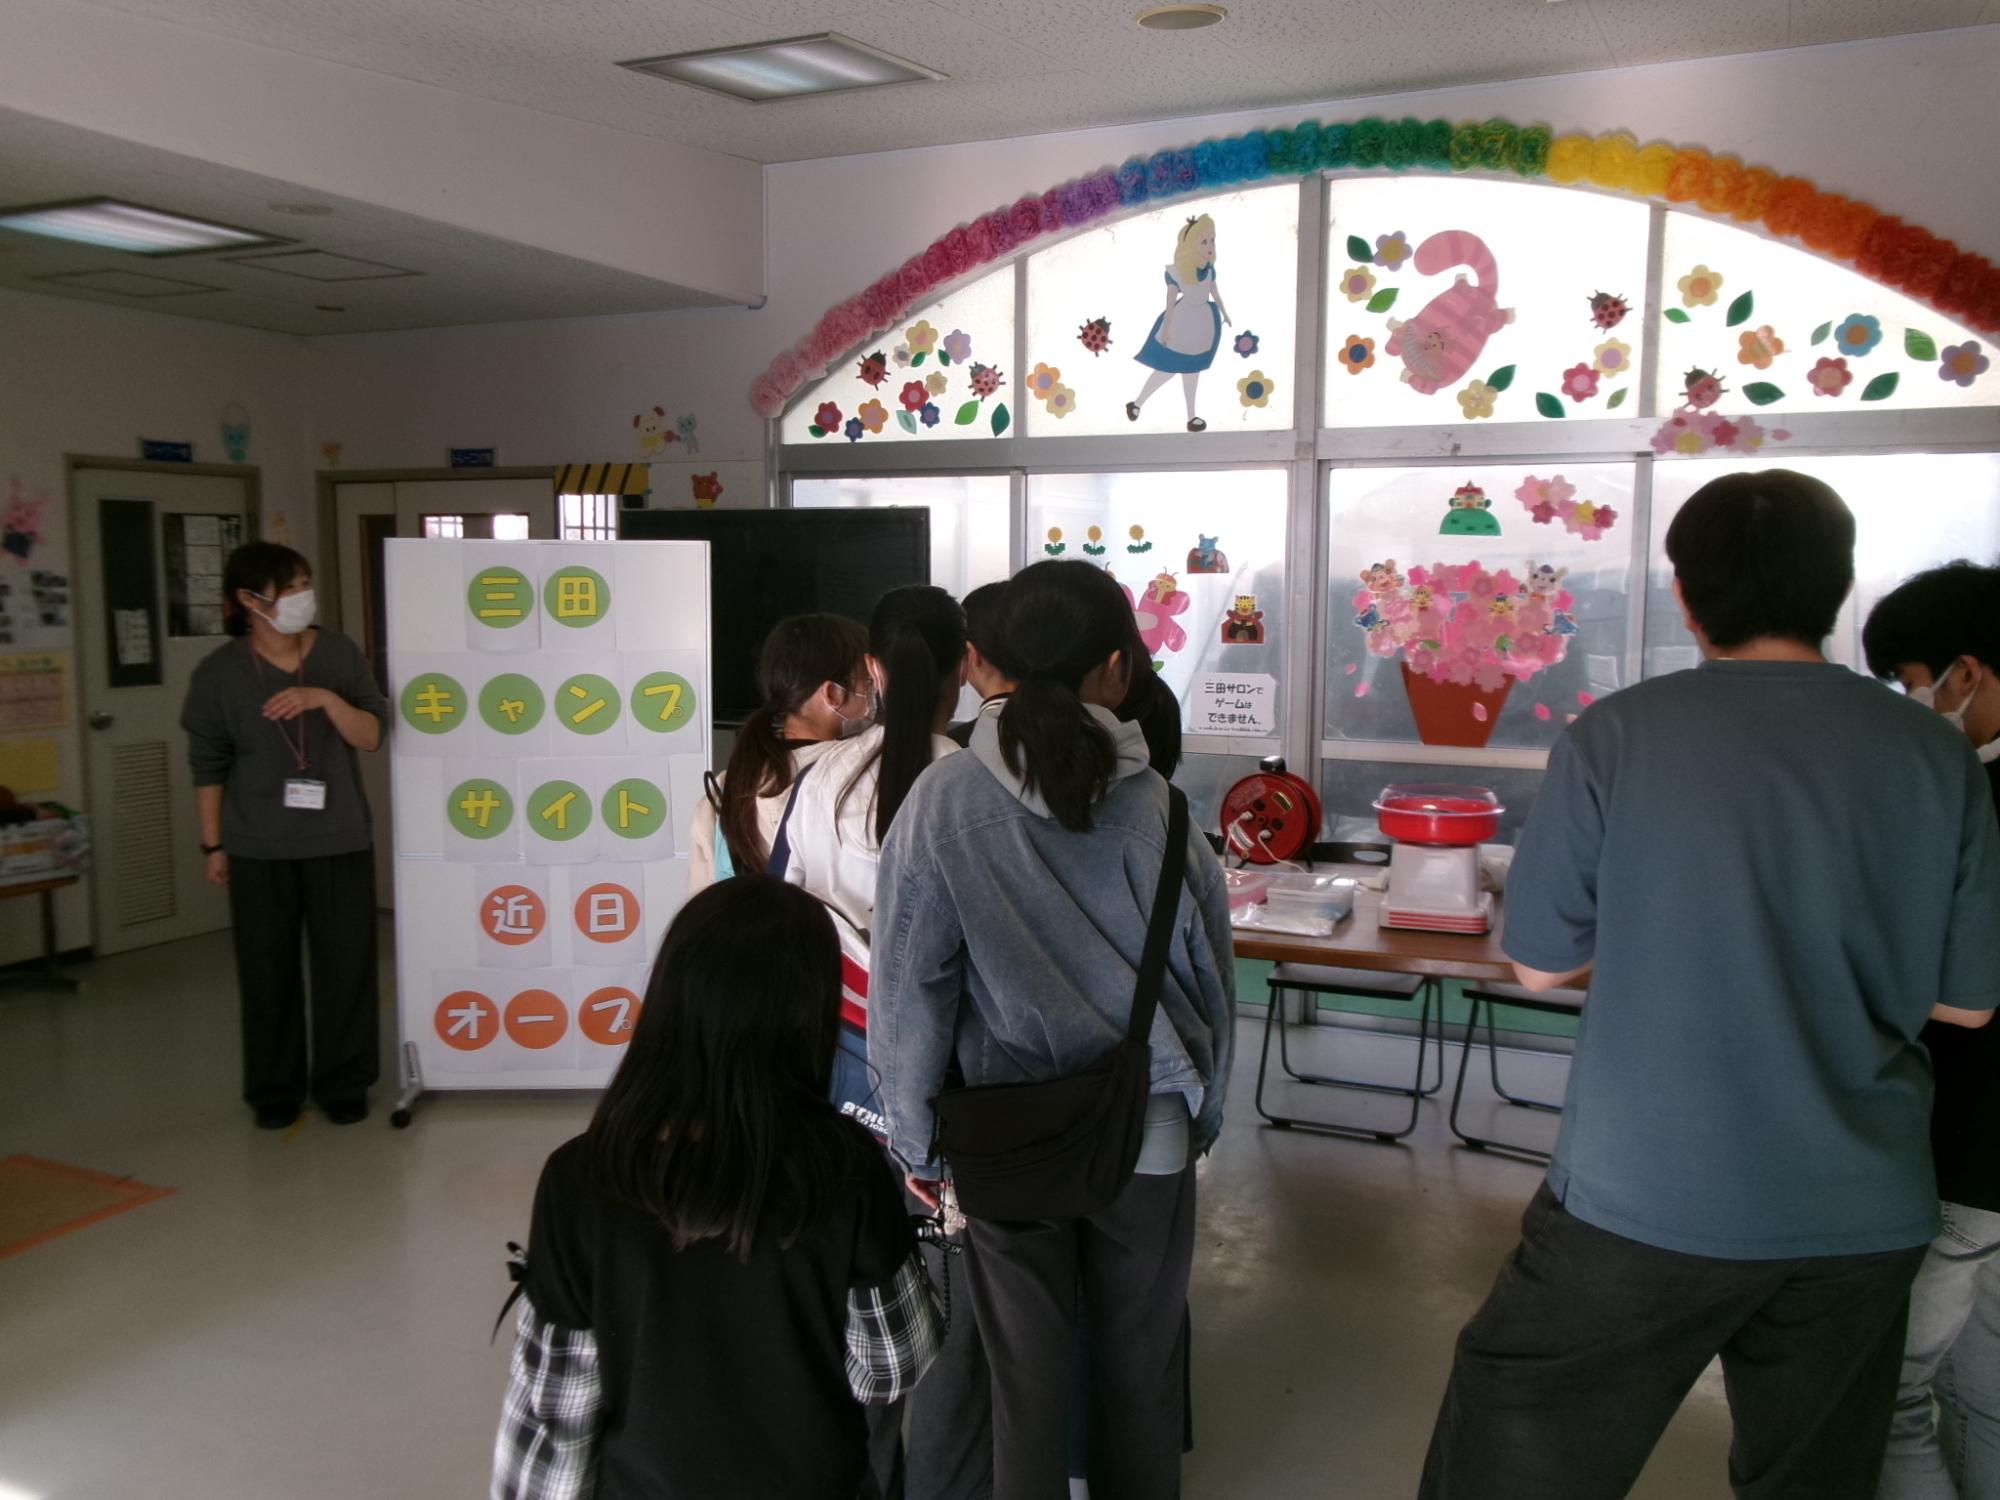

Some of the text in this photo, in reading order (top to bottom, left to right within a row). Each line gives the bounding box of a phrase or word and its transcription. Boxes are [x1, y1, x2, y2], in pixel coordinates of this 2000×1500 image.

[479, 576, 598, 619] 三田
[413, 682, 685, 725] キャンプ
[1204, 682, 1264, 695] 三田サロンで
[1215, 697, 1252, 710] ゲームは
[1207, 712, 1262, 725] できません。
[459, 789, 650, 830] サイト
[491, 892, 626, 935] 近日
